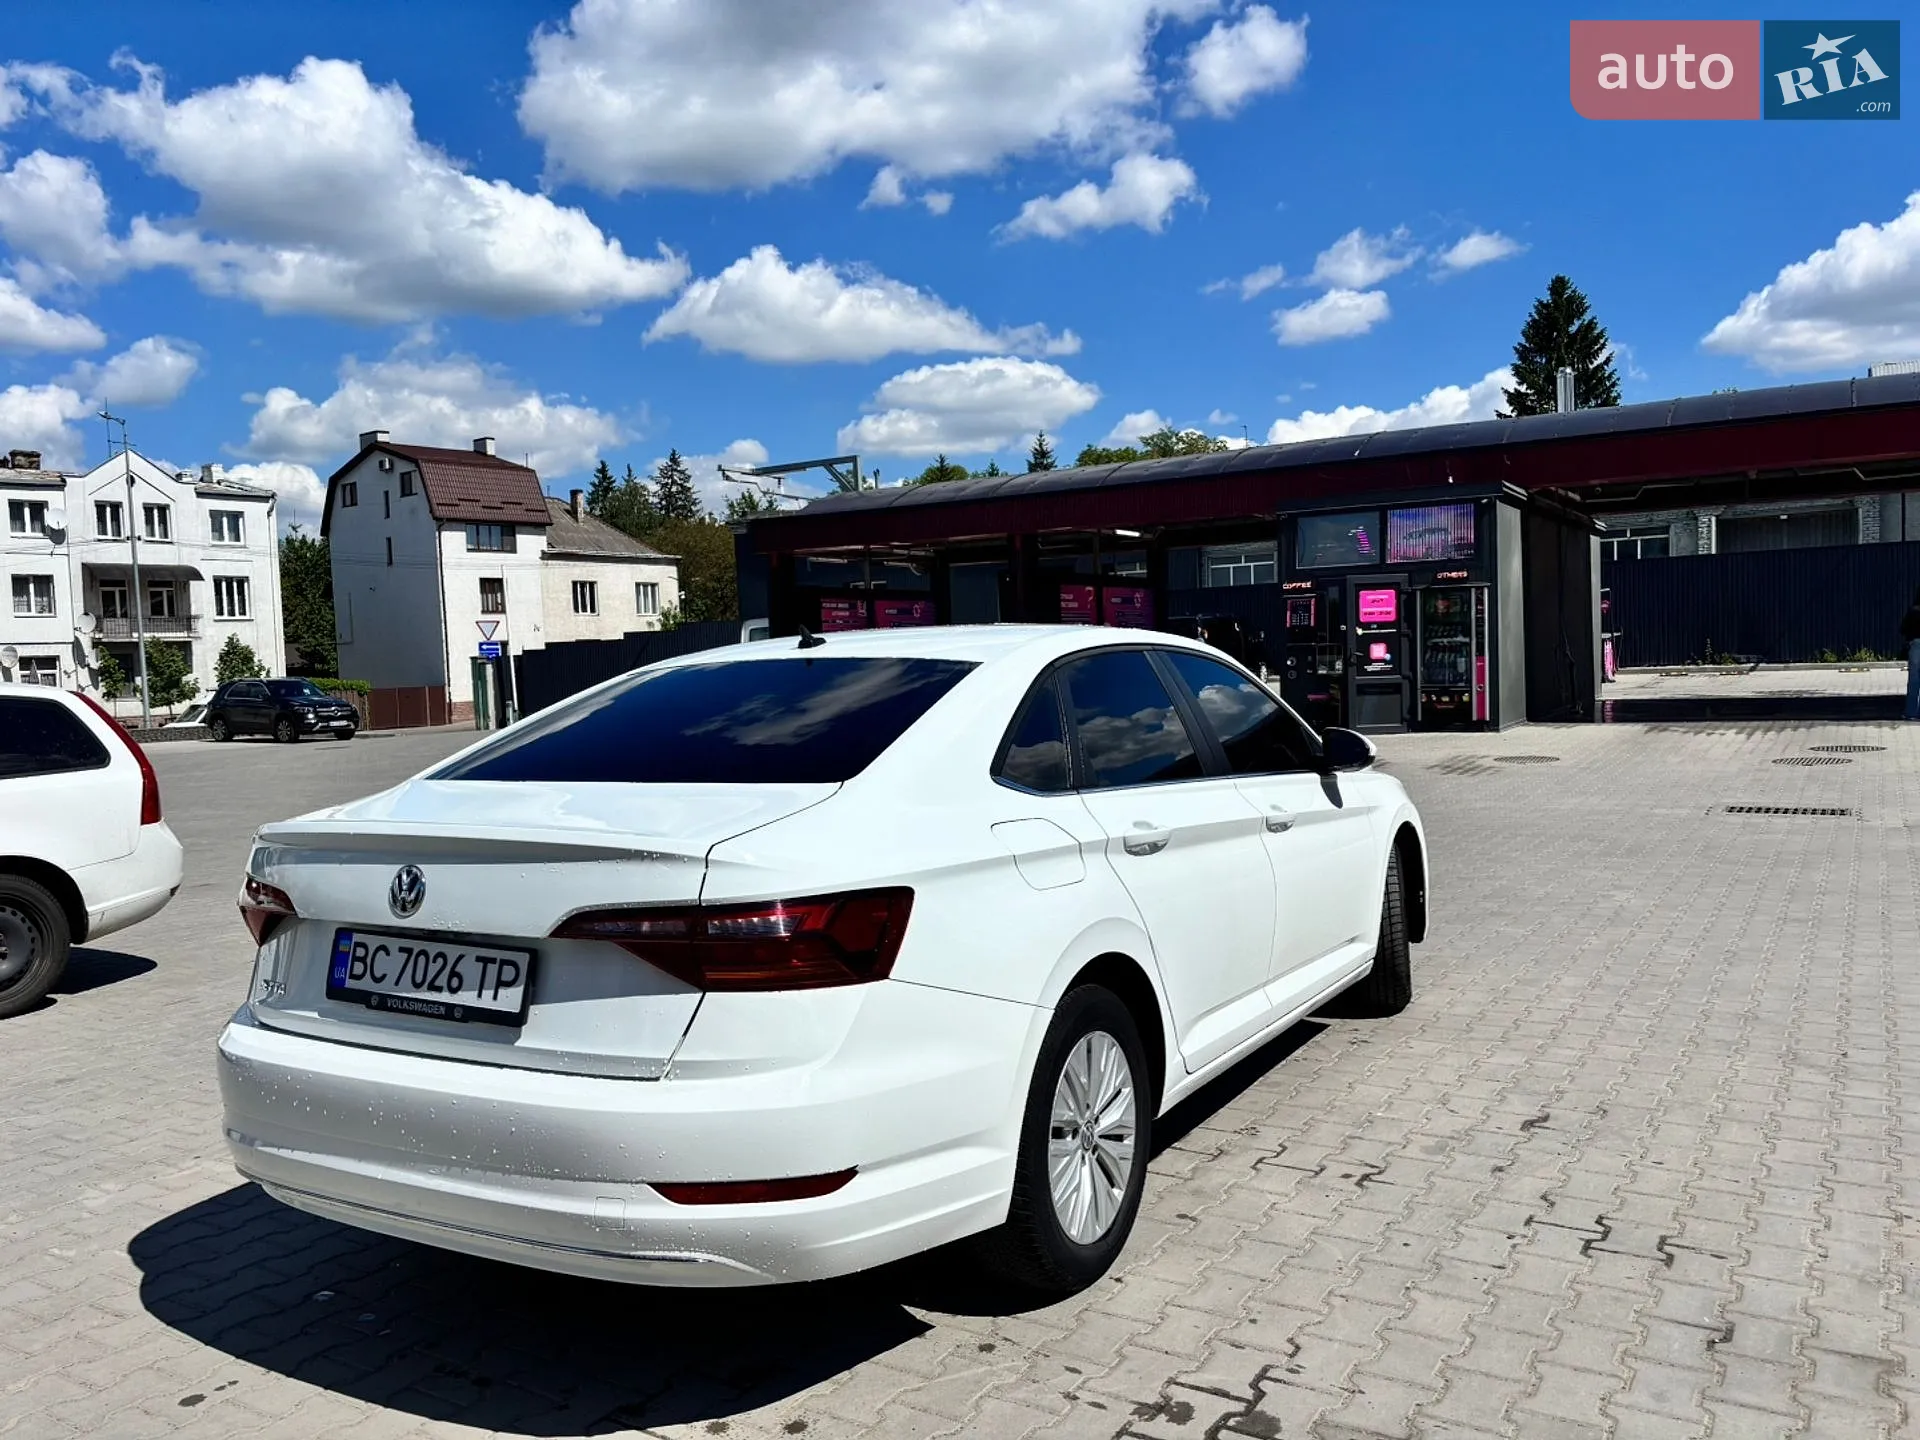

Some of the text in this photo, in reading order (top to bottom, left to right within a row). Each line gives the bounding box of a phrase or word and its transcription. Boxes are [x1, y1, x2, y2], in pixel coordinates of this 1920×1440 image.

[348, 941, 520, 1001] BC 7026 TP
[386, 997, 447, 1016] VOLKSWAGEN
